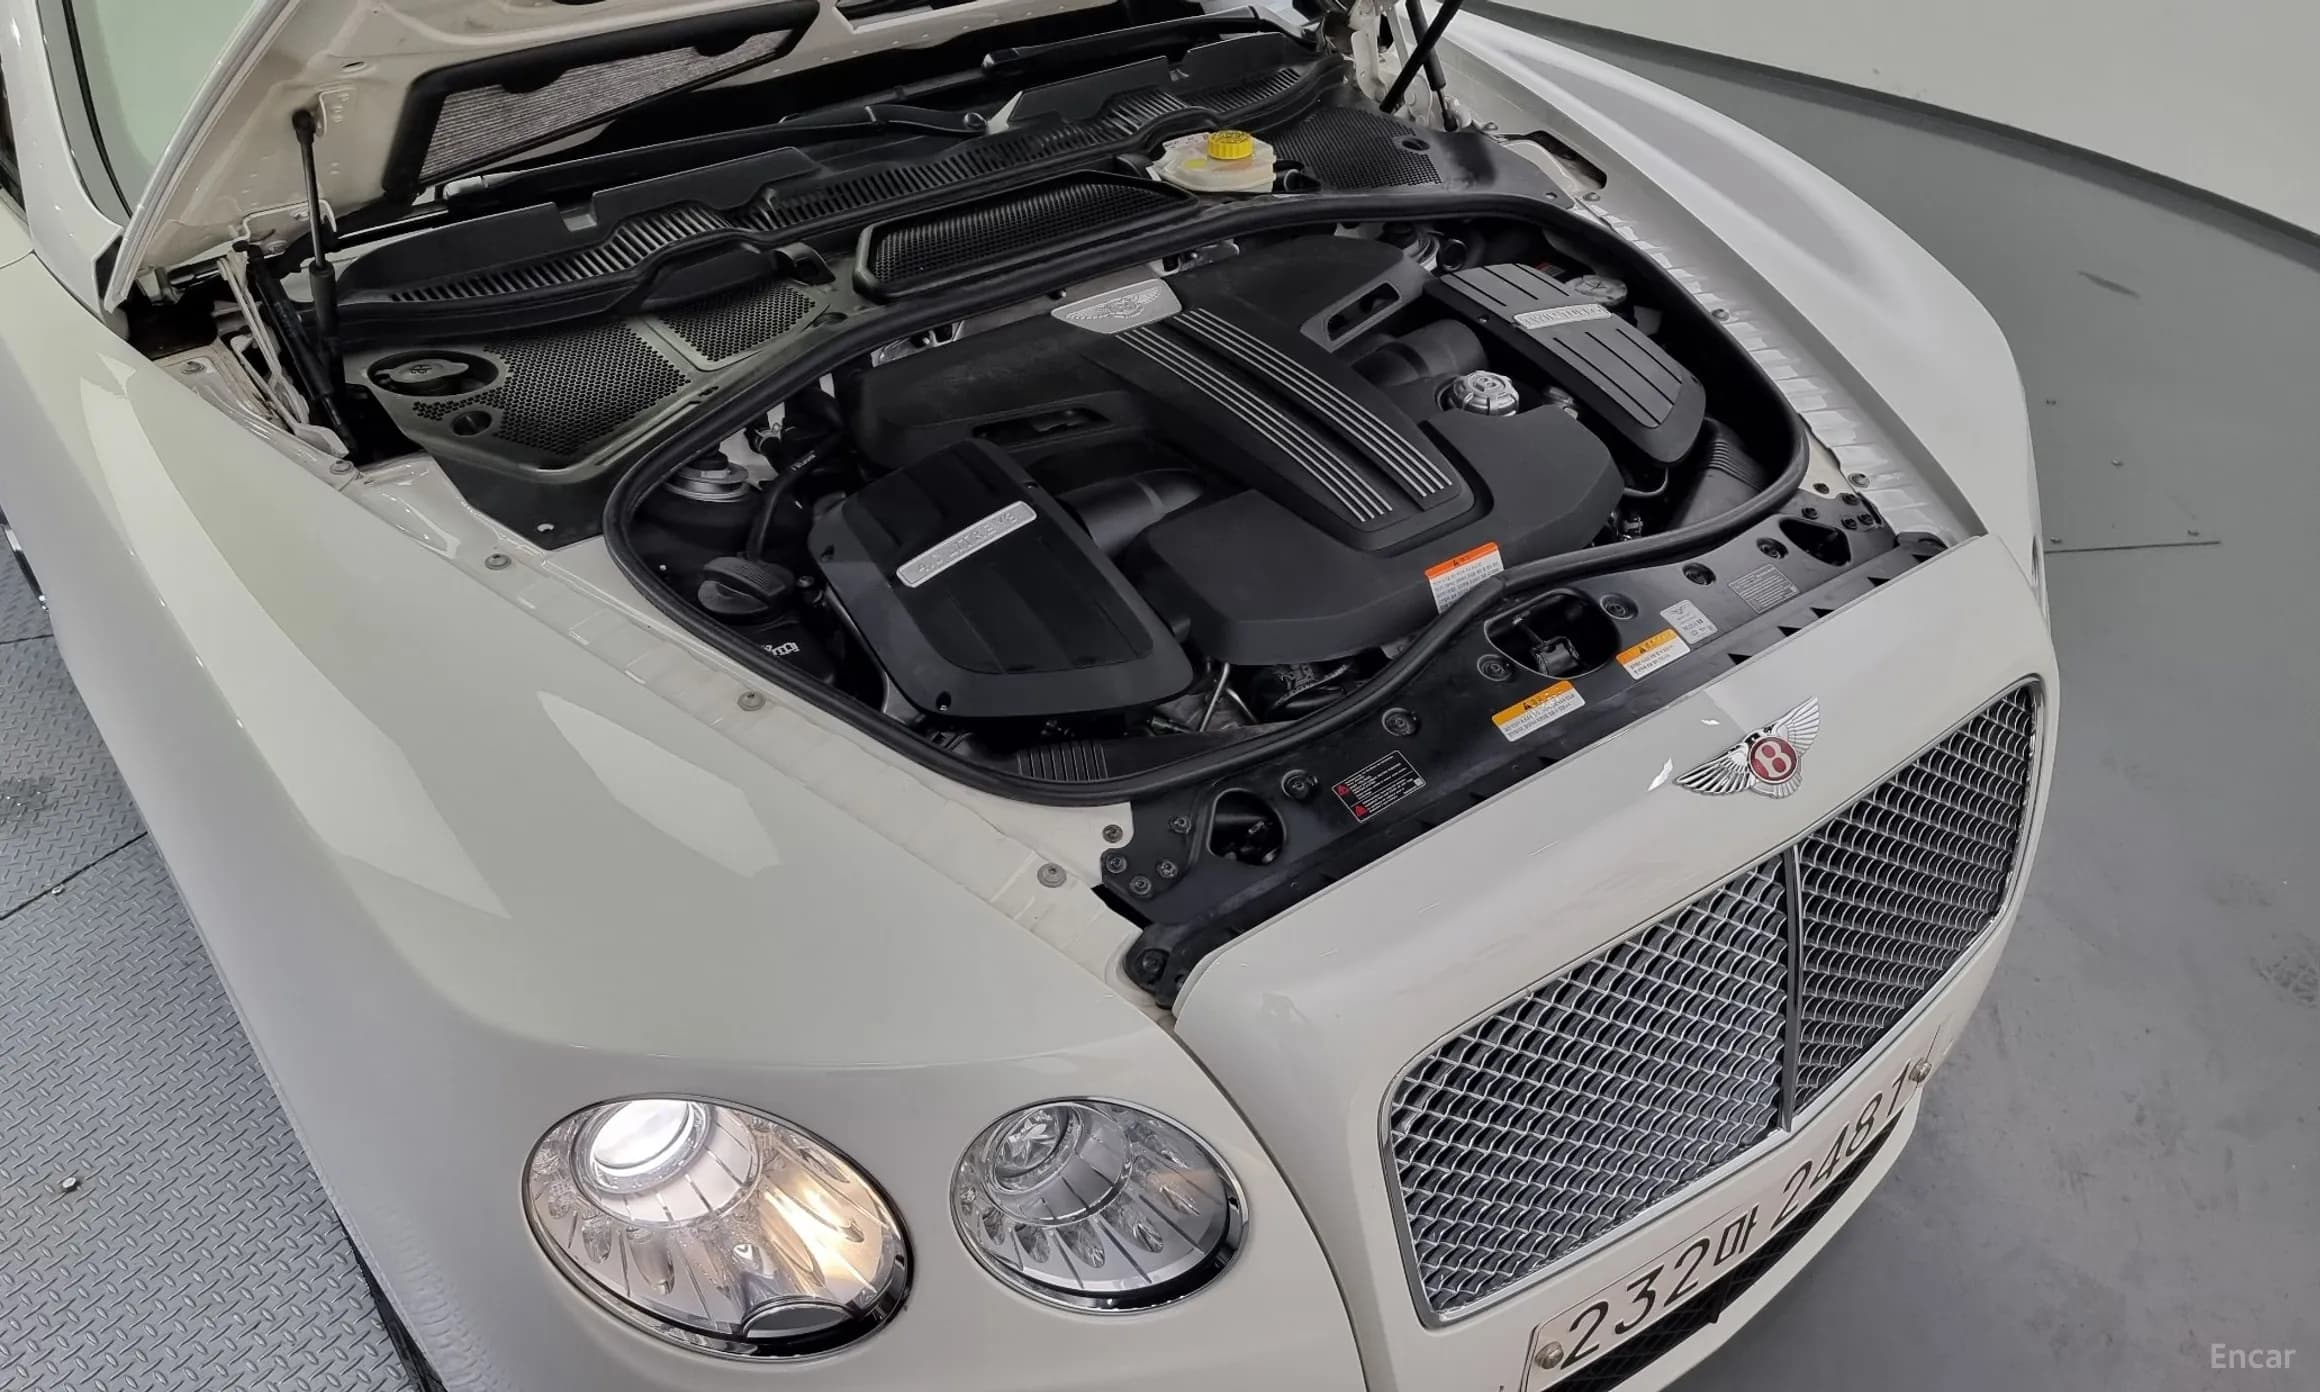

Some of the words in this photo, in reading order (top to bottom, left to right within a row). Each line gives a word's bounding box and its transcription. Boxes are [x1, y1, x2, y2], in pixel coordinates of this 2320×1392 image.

[1755, 741, 1792, 778] B
[1560, 1204, 1758, 1370] 232마
[1770, 1063, 1910, 1232] 2481
